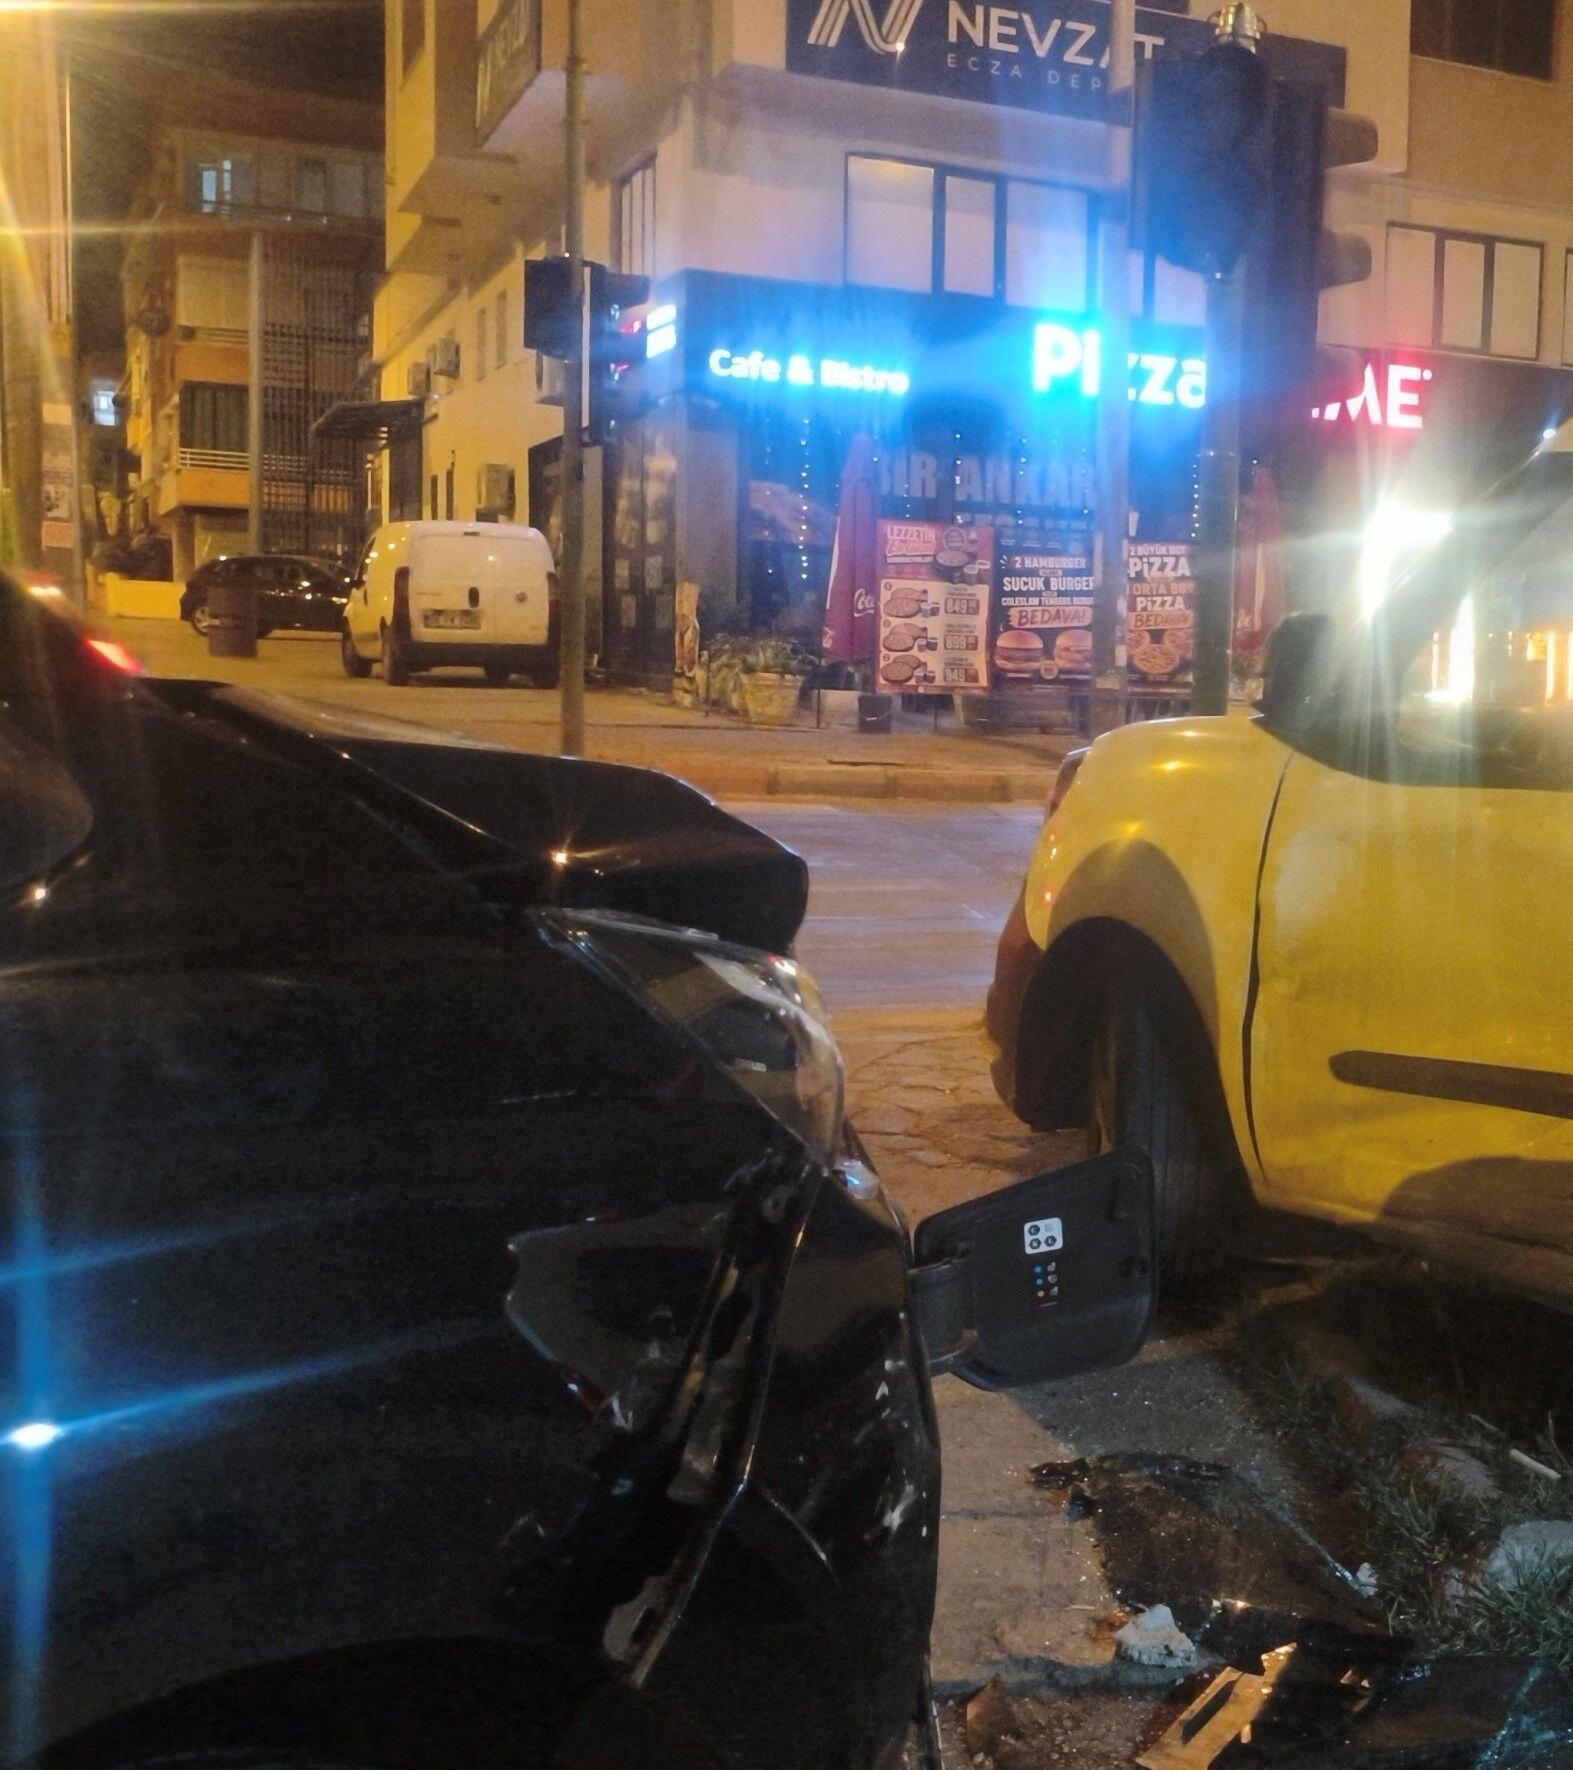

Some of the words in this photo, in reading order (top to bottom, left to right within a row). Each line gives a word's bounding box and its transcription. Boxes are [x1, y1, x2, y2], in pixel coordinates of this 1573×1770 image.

[948, 1, 1165, 69] NEVZT
[947, 53, 1023, 79] ECZA
[1047, 70, 1102, 90] DEP
[709, 349, 781, 382] Cafe
[787, 355, 814, 386] &
[820, 359, 909, 394] Bistro
[1033, 322, 1207, 408] Piza
[1311, 362, 1423, 429] ME
[953, 454, 1097, 507] ANKAR
[1014, 556, 1021, 568] 2
[1024, 556, 1086, 568] HAMBURGER
[1002, 576, 1046, 592] SUCUK
[1017, 608, 1086, 627] BEDAVA!
